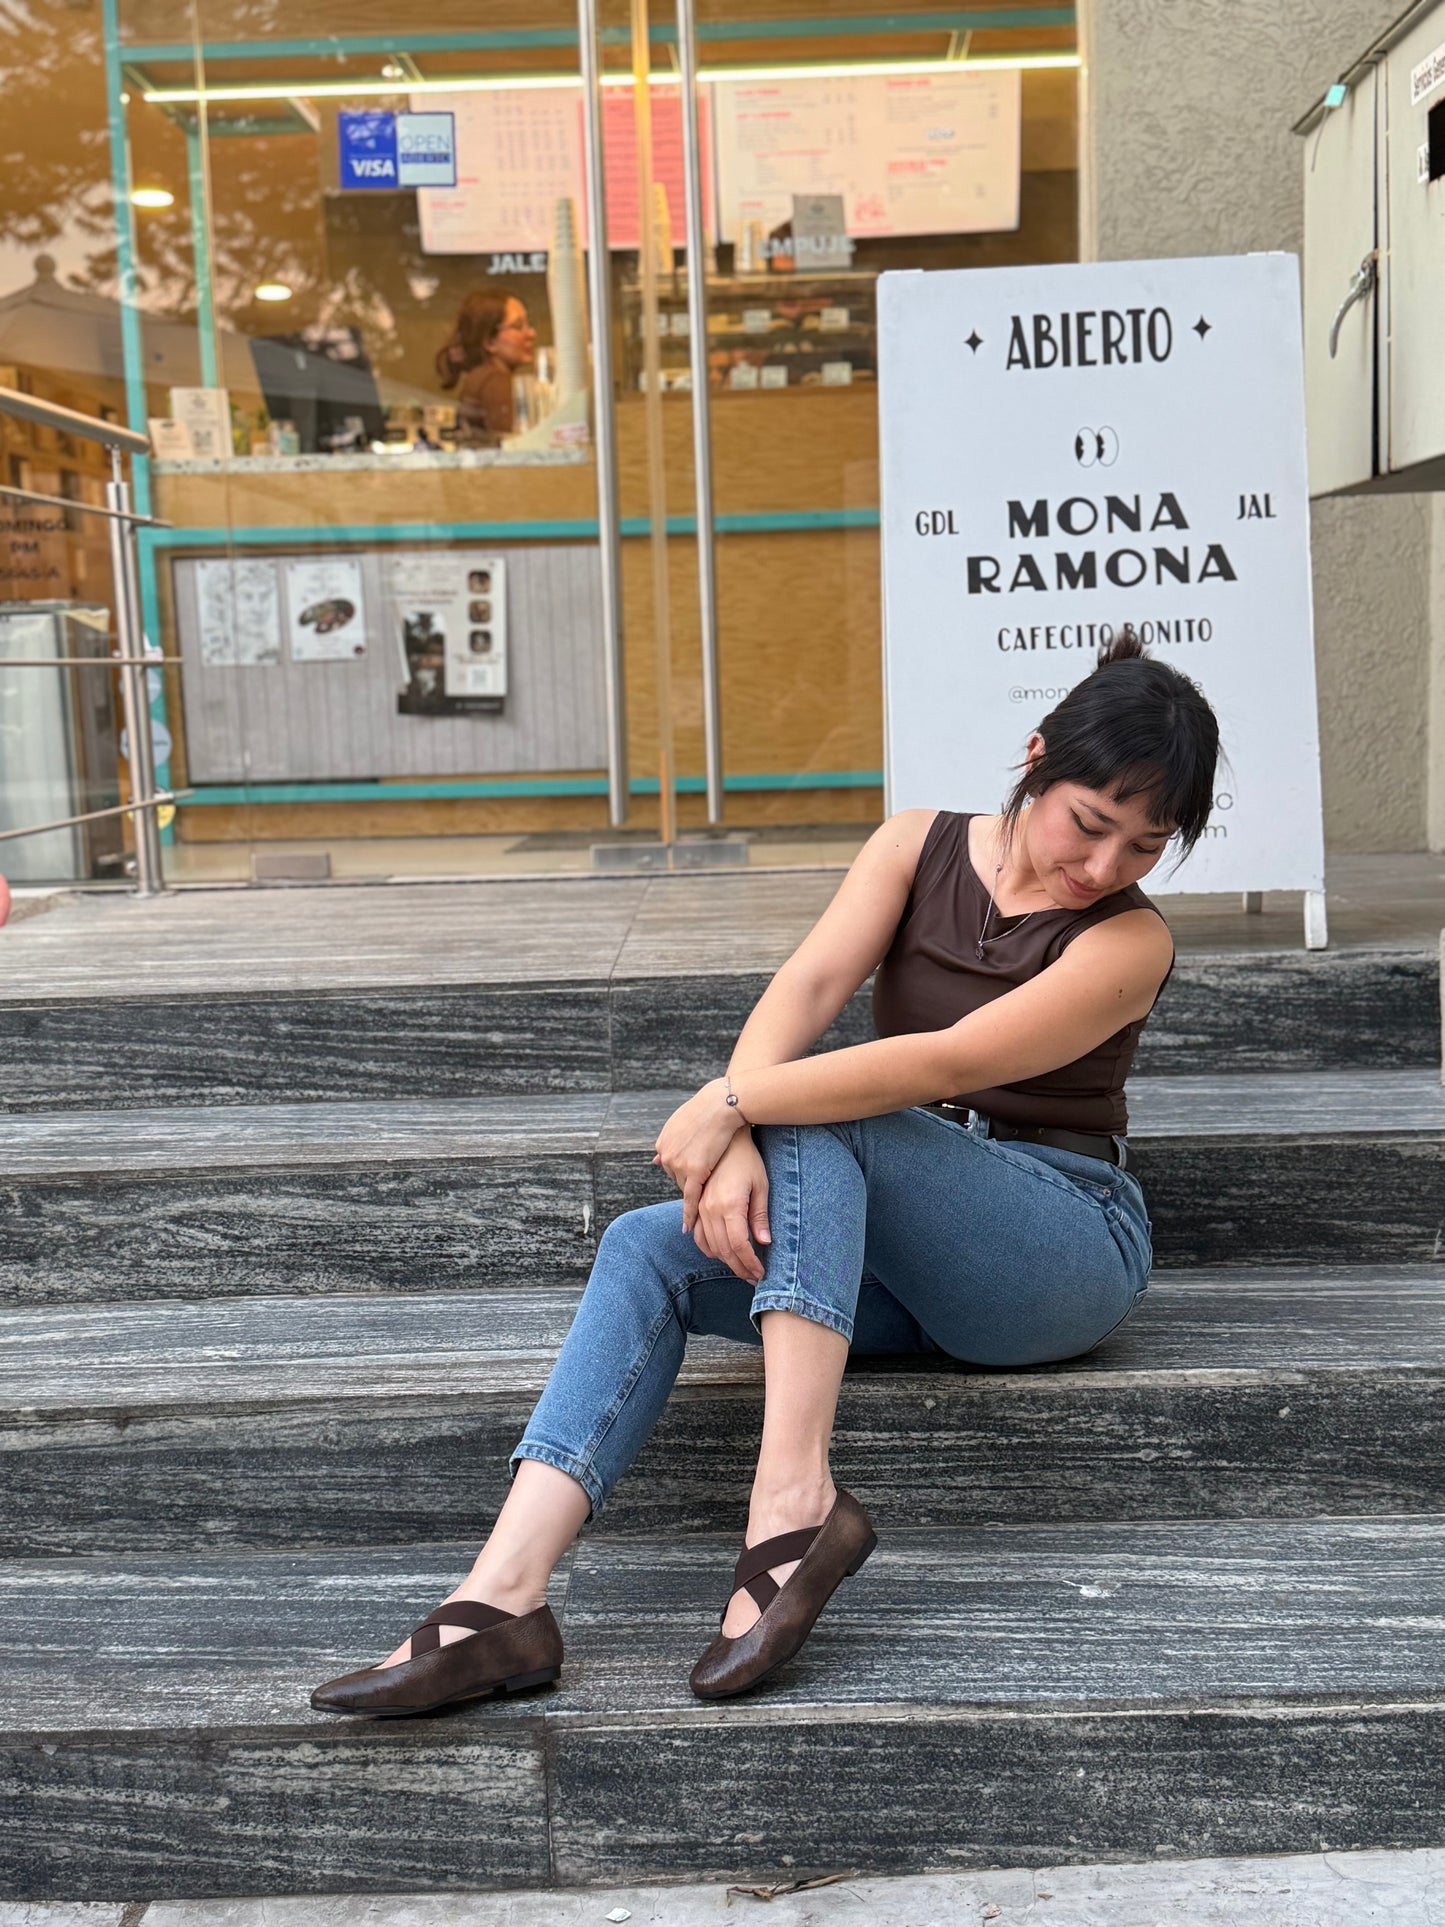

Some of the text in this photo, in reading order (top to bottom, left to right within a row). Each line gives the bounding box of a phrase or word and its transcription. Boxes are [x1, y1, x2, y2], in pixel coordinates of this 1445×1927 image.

[400, 134, 450, 152] OPEN
[350, 158, 395, 178] VISA
[486, 252, 547, 275] JALE
[1005, 306, 1173, 371] ABIERTO
[1006, 492, 1190, 538] MONA
[1236, 493, 1277, 520] JAL
[915, 510, 960, 536] GDL
[966, 543, 1238, 594] RAMONA
[997, 618, 1213, 652] CAFECITO BONITO
